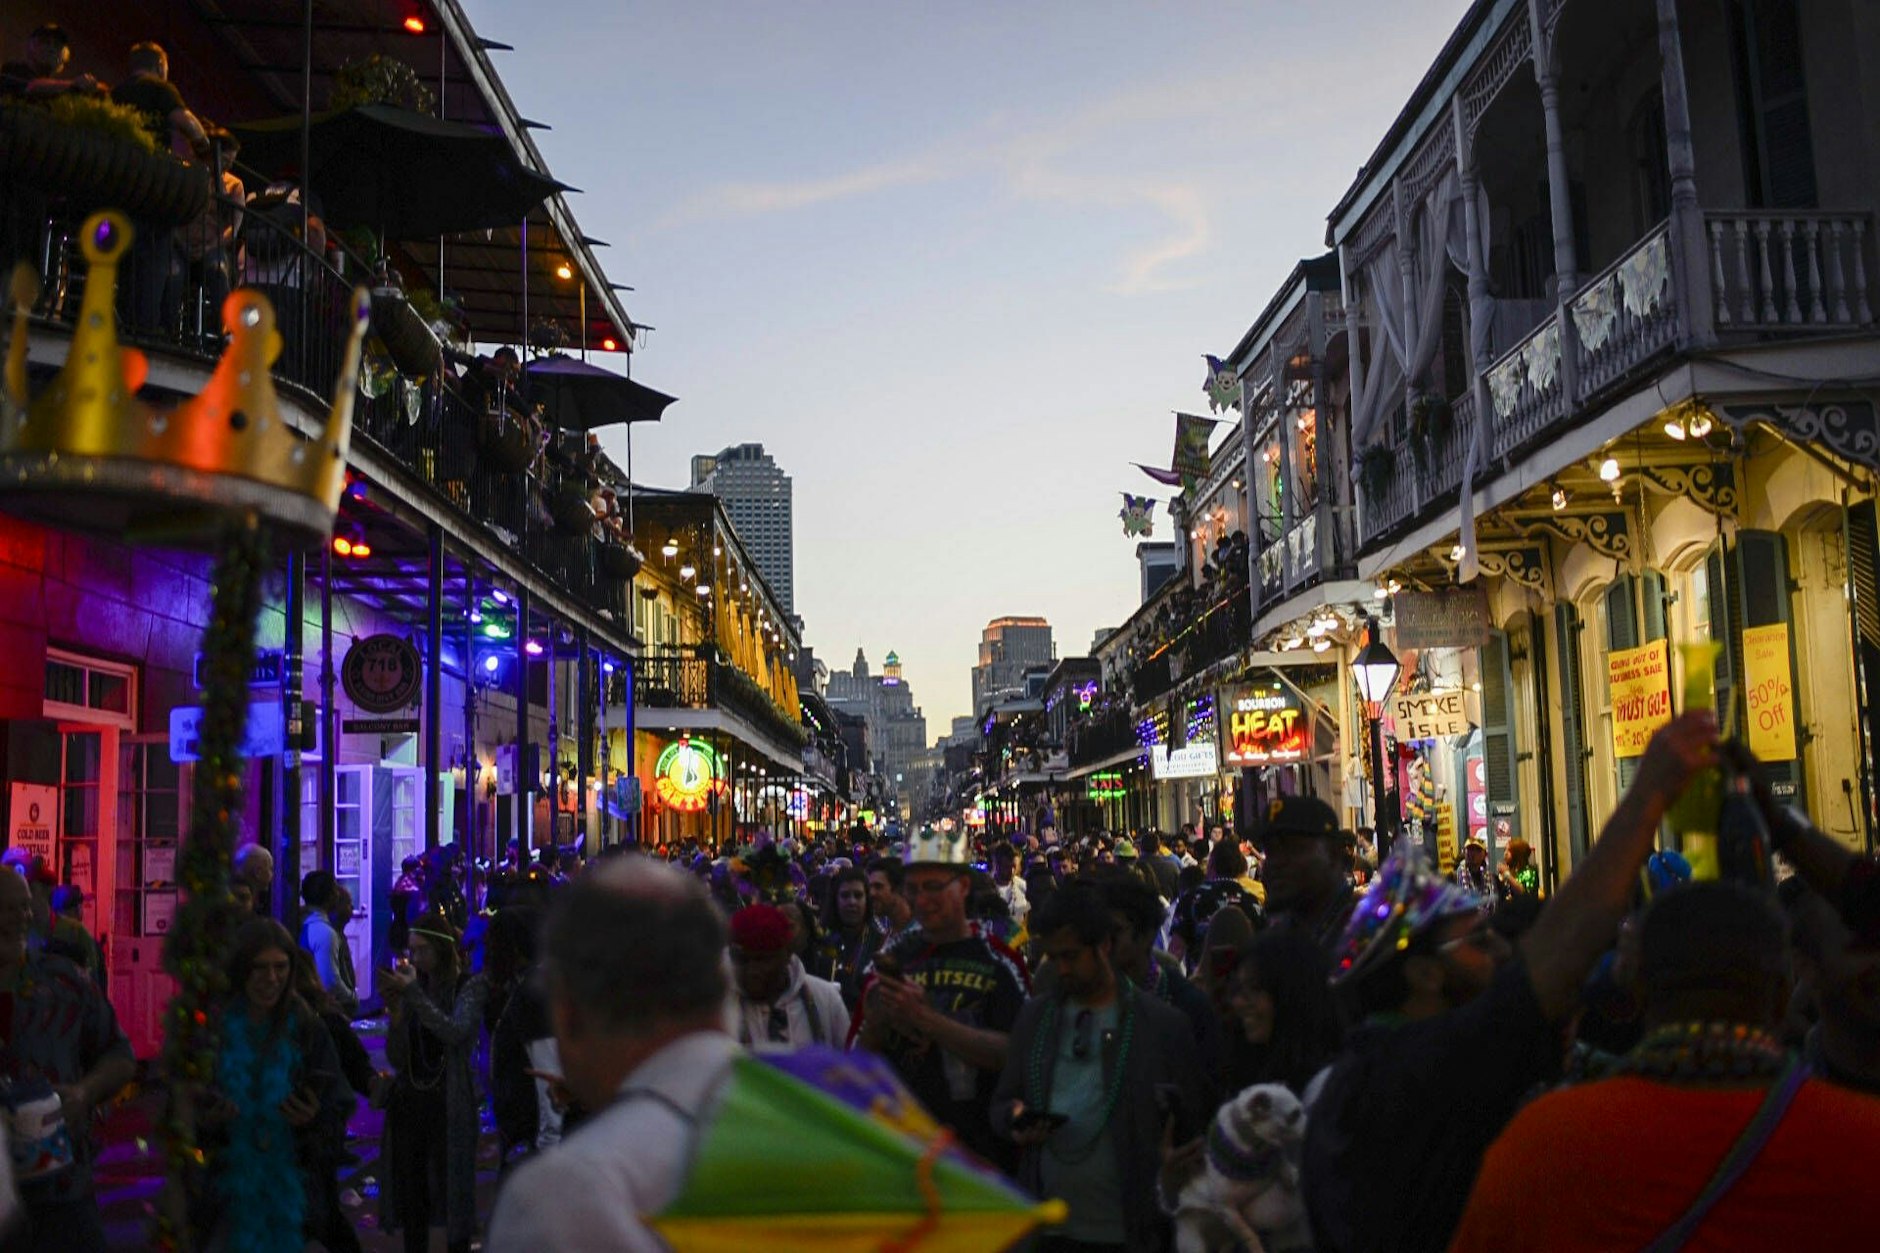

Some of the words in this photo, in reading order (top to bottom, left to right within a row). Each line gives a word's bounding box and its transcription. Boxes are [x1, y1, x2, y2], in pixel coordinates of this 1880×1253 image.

[1237, 697, 1286, 711] BOURBON
[1749, 677, 1789, 709] 50%
[1616, 694, 1645, 723] MUST
[1758, 703, 1786, 731] Off
[1231, 709, 1299, 749] HEAT
